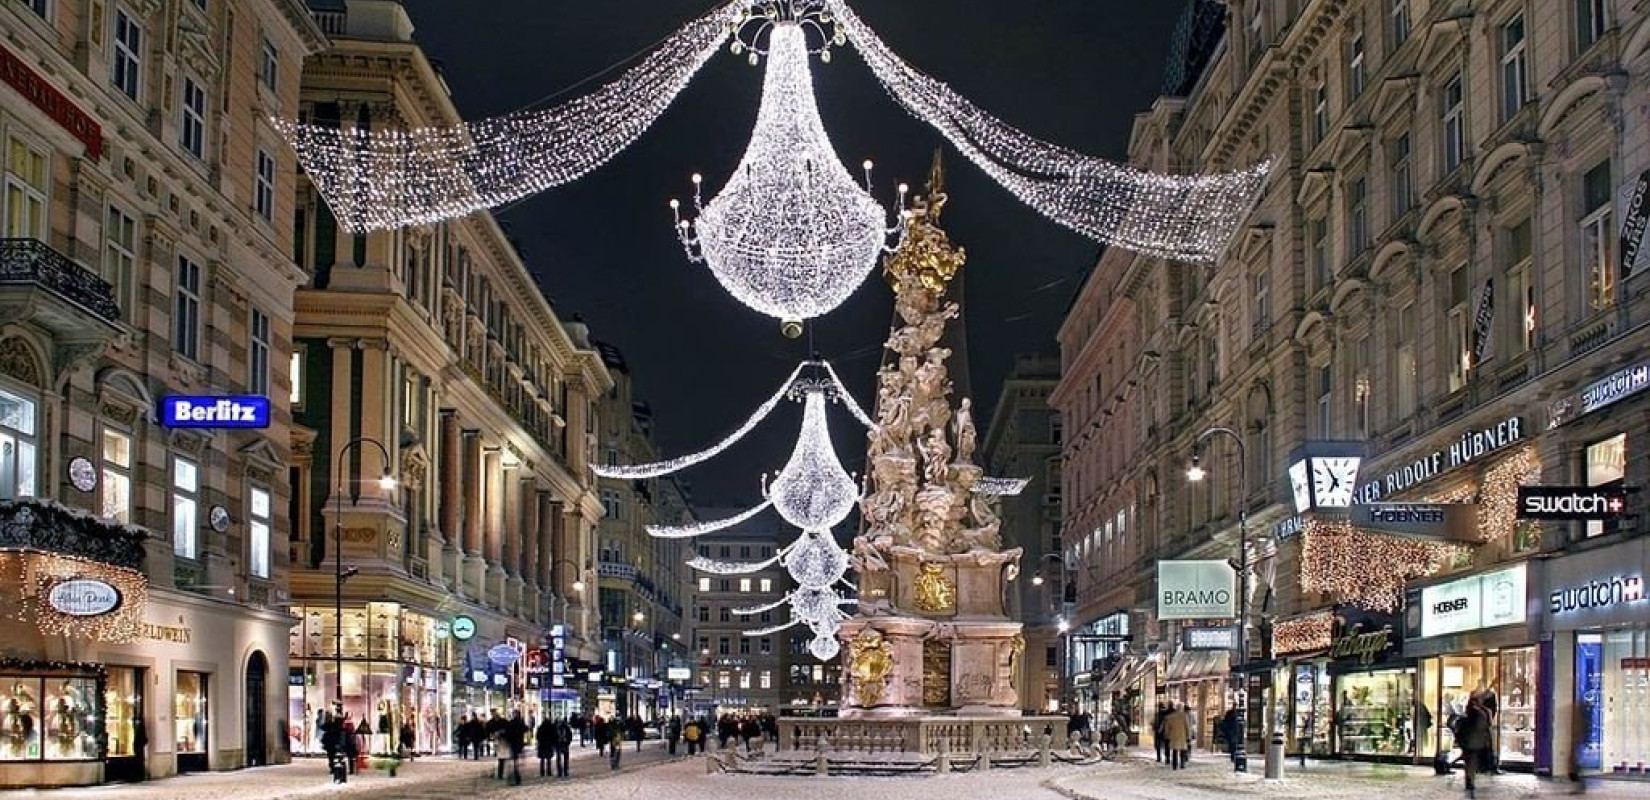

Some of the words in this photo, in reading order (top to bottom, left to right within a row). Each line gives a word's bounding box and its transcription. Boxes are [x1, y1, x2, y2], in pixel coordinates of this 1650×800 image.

[175, 400, 256, 421] Berlitz
[1387, 452, 1443, 493] RUDOLF
[1450, 416, 1521, 466] HÜBNER
[1525, 492, 1608, 513] swatch
[1163, 589, 1230, 606] BRAMO
[1549, 576, 1623, 614] swatch
